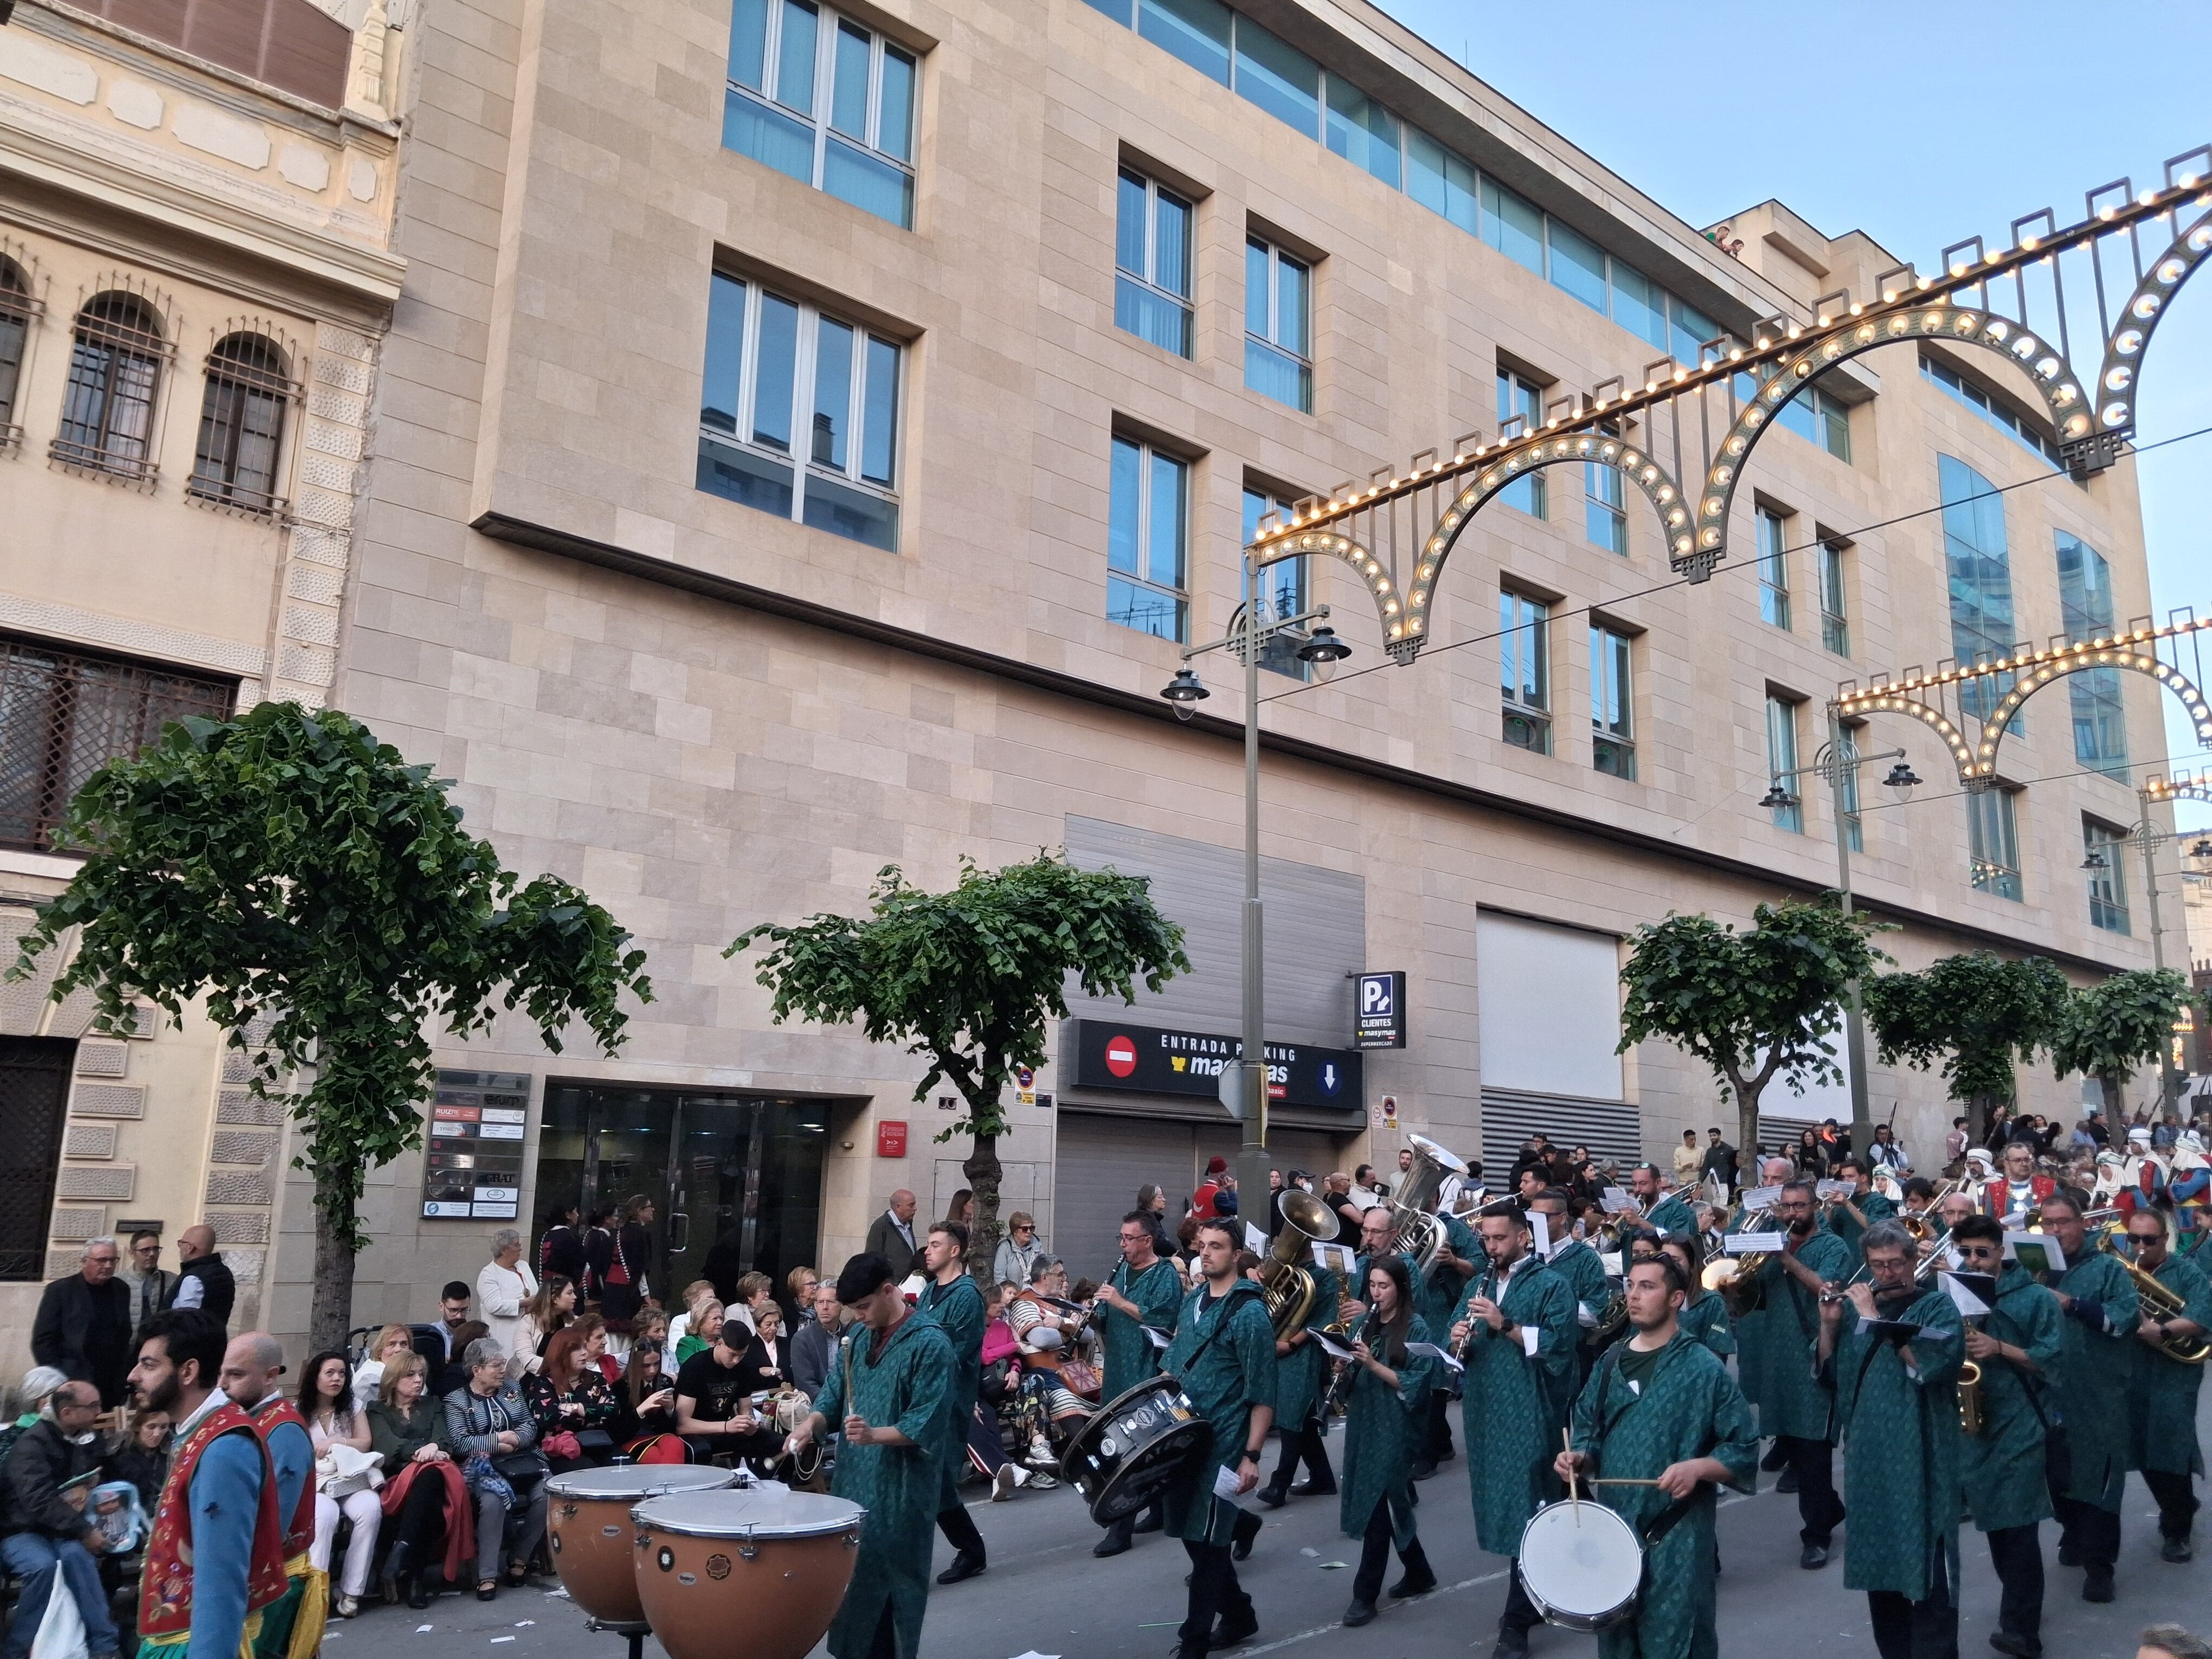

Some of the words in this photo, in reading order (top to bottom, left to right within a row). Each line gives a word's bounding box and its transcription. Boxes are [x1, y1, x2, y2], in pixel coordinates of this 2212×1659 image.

[1364, 981, 1382, 1012] P
[1361, 1019, 1392, 1028] CLIENTES
[1161, 1034, 1227, 1054] ENTRADA
[1236, 1043, 1296, 1062] PKING
[1190, 1057, 1288, 1083] maas
